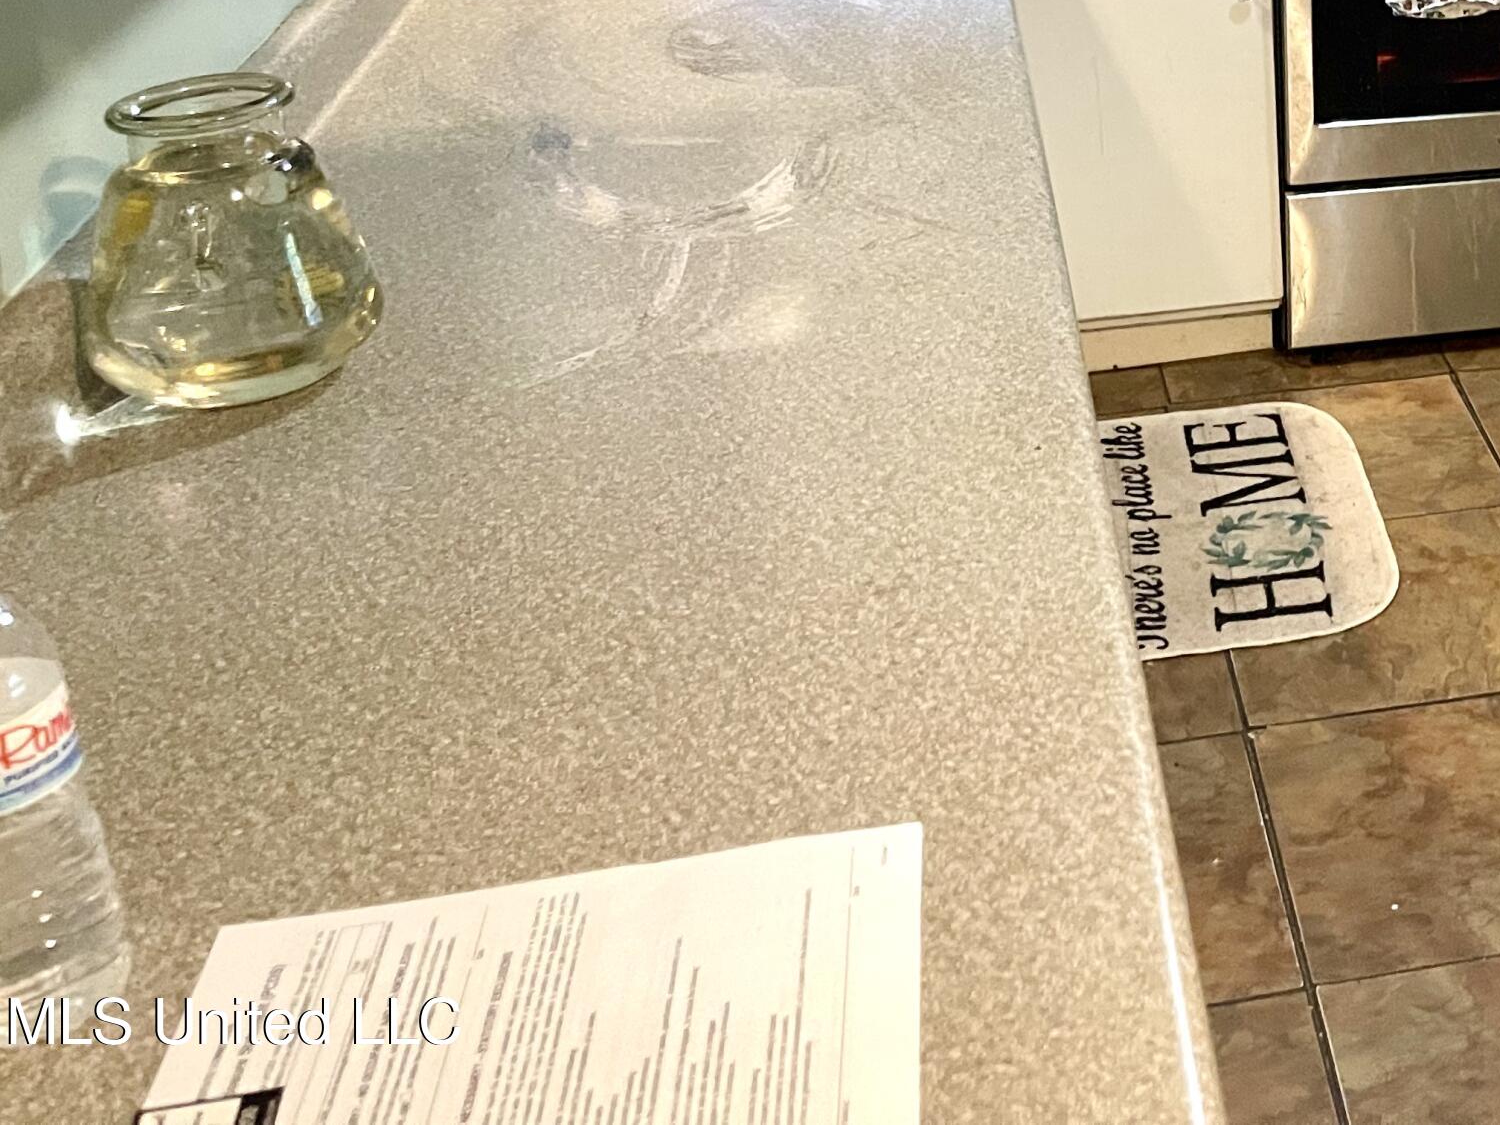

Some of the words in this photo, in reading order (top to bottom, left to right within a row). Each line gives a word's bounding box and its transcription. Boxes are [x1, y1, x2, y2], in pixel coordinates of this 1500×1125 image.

[1100, 422, 1146, 461] like
[1111, 463, 1172, 520] place
[1128, 527, 1162, 555] no
